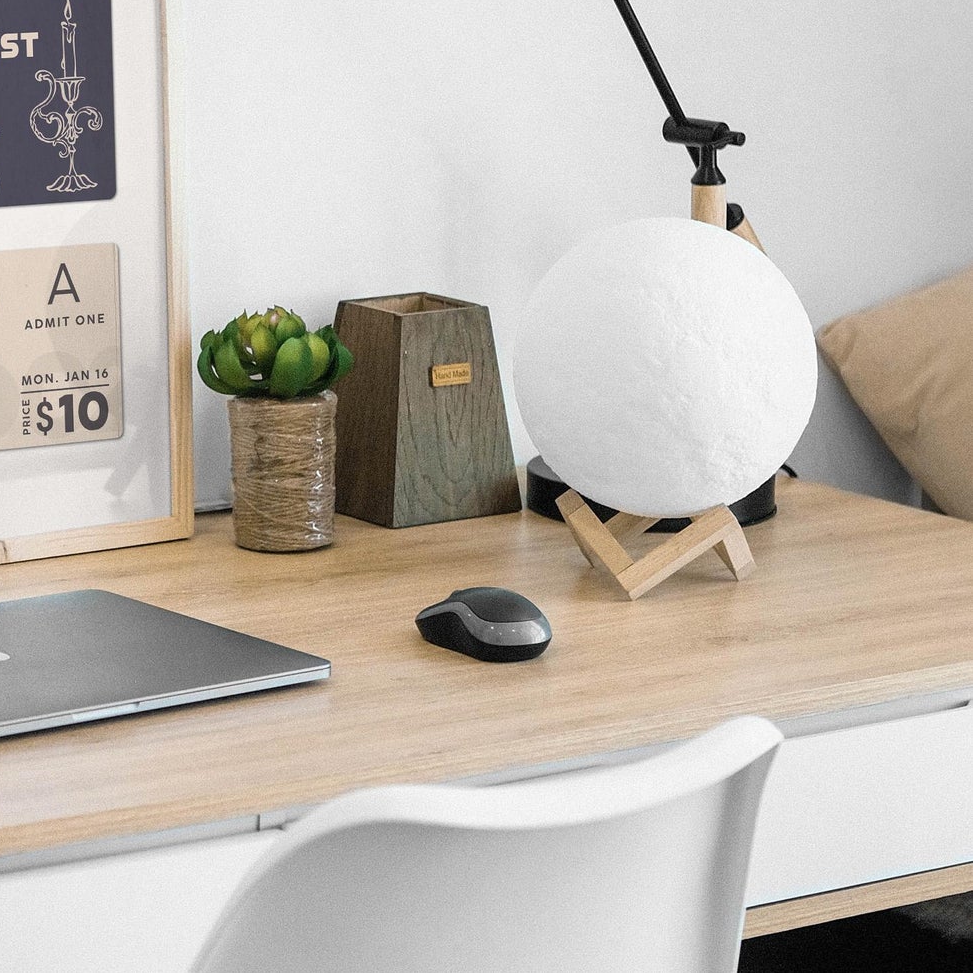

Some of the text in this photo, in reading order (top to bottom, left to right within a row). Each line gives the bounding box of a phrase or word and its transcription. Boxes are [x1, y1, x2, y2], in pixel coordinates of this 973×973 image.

[48, 263, 80, 305] A
[25, 314, 105, 330] ADMIT ONE
[22, 369, 108, 386] MON. JAN 16
[36, 391, 108, 436] $10
